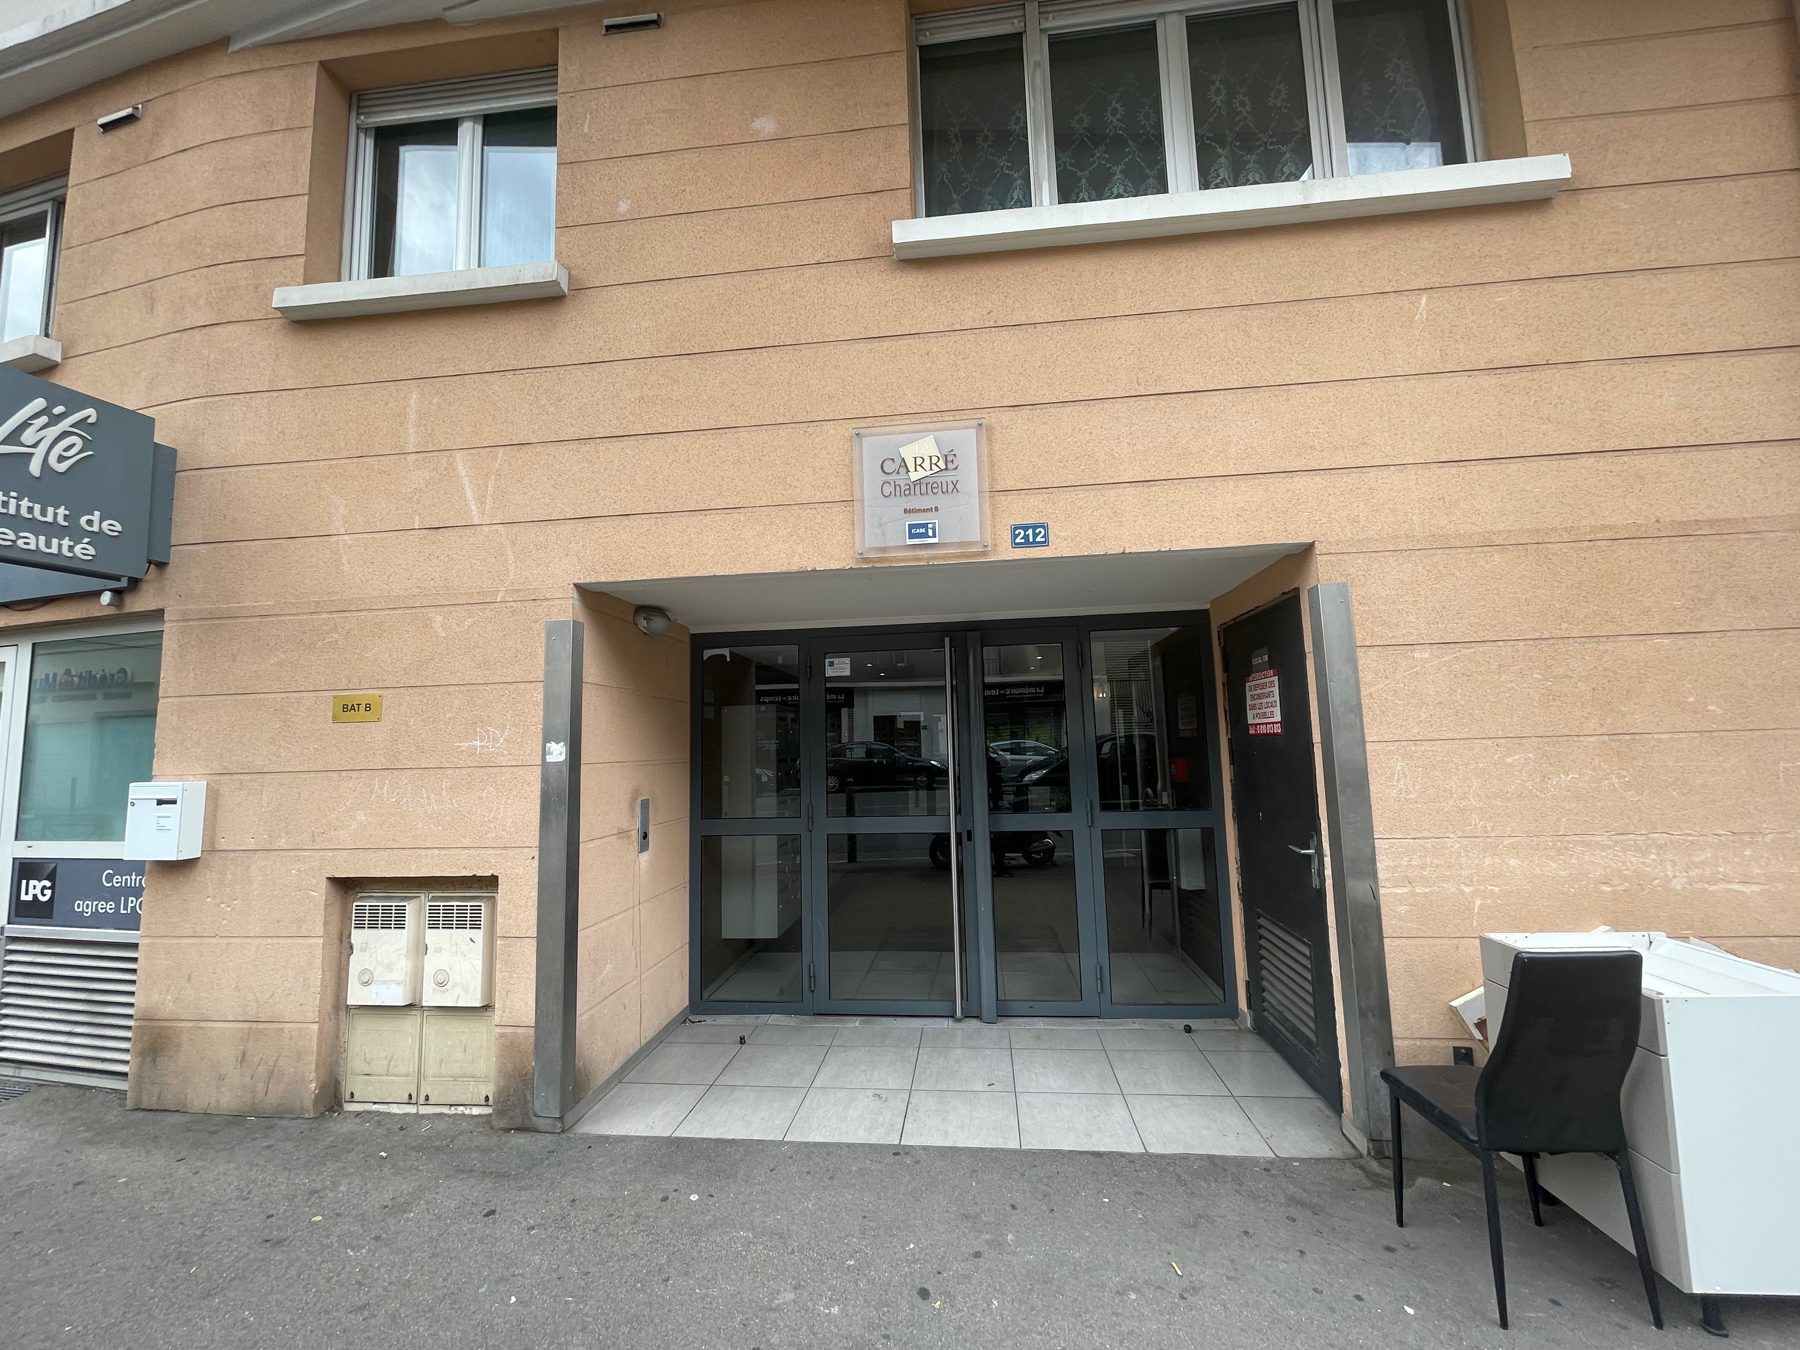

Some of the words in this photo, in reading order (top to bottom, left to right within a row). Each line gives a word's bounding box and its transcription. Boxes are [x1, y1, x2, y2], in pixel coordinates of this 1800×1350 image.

[880, 448, 960, 475] CARRÉ
[880, 479, 960, 498] Chartreux
[80, 510, 123, 536] de
[0, 527, 97, 560] eauté
[1014, 528, 1046, 543] 212
[342, 704, 361, 713] BAT
[364, 703, 371, 712] B
[20, 879, 53, 902] LPG
[74, 900, 115, 917] agree
